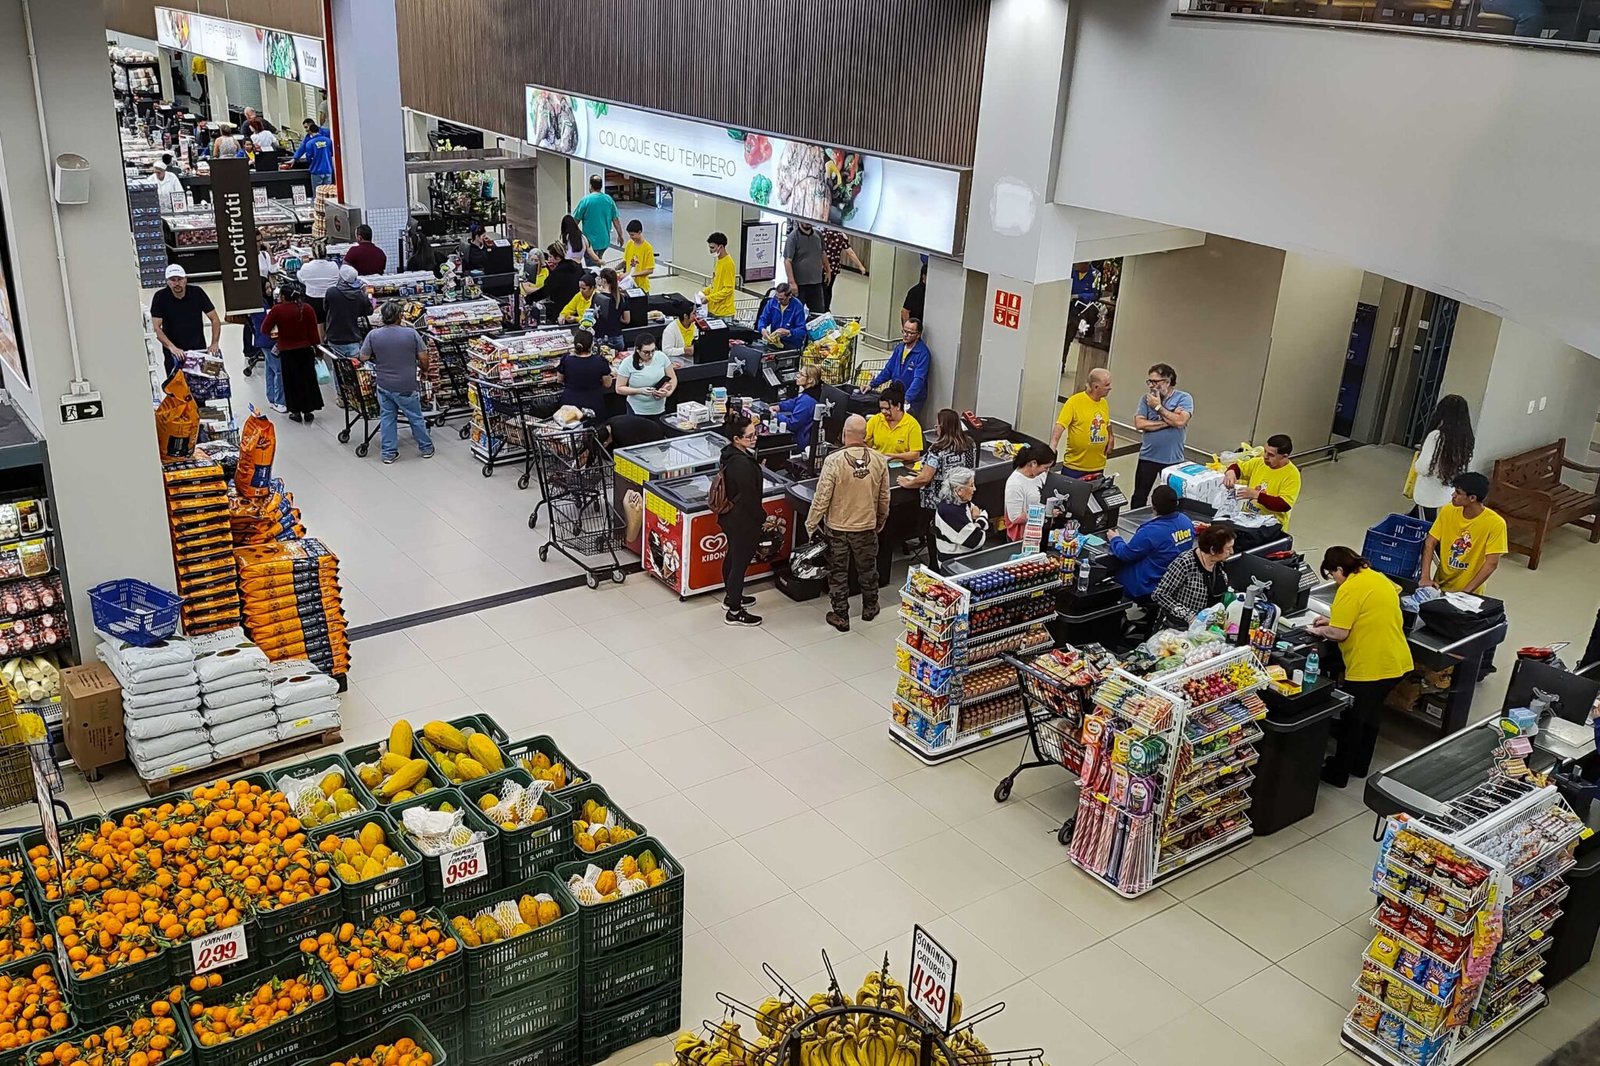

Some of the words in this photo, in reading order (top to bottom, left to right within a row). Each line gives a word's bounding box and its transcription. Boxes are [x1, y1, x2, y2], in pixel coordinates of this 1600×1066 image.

[303, 50, 318, 68] Vitor
[598, 129, 650, 157] COLOQUE
[653, 142, 675, 162] SEU
[678, 148, 736, 177] TEMPERO
[224, 193, 249, 281] Hortifrúti
[1089, 435, 1106, 443] Vitor
[656, 522, 670, 534] KIBON
[1171, 528, 1192, 543] Vitor
[701, 551, 726, 563] KIBON
[1448, 556, 1469, 569] Vitor
[529, 848, 554, 861] S.VITOR
[373, 900, 400, 915] S.VITOR
[1382, 904, 1401, 918] Doritos
[615, 911, 655, 930] SUPER.VITOR
[1408, 914, 1428, 932] Doritos
[200, 931, 233, 948] PONKAN
[288, 929, 317, 944] S.VITOR
[1436, 929, 1454, 947] Doritos
[916, 932, 945, 968] BANANA
[1378, 940, 1392, 953] Lay's
[504, 951, 549, 972] SUPER.VITOR
[916, 949, 946, 983] CATURRA
[107, 993, 142, 1010] S.VITOR
[381, 992, 431, 1015] SUPER.VITOR
[503, 1004, 548, 1026] SUPER.VITOR
[248, 1043, 299, 1066] SUPER.VITOR
